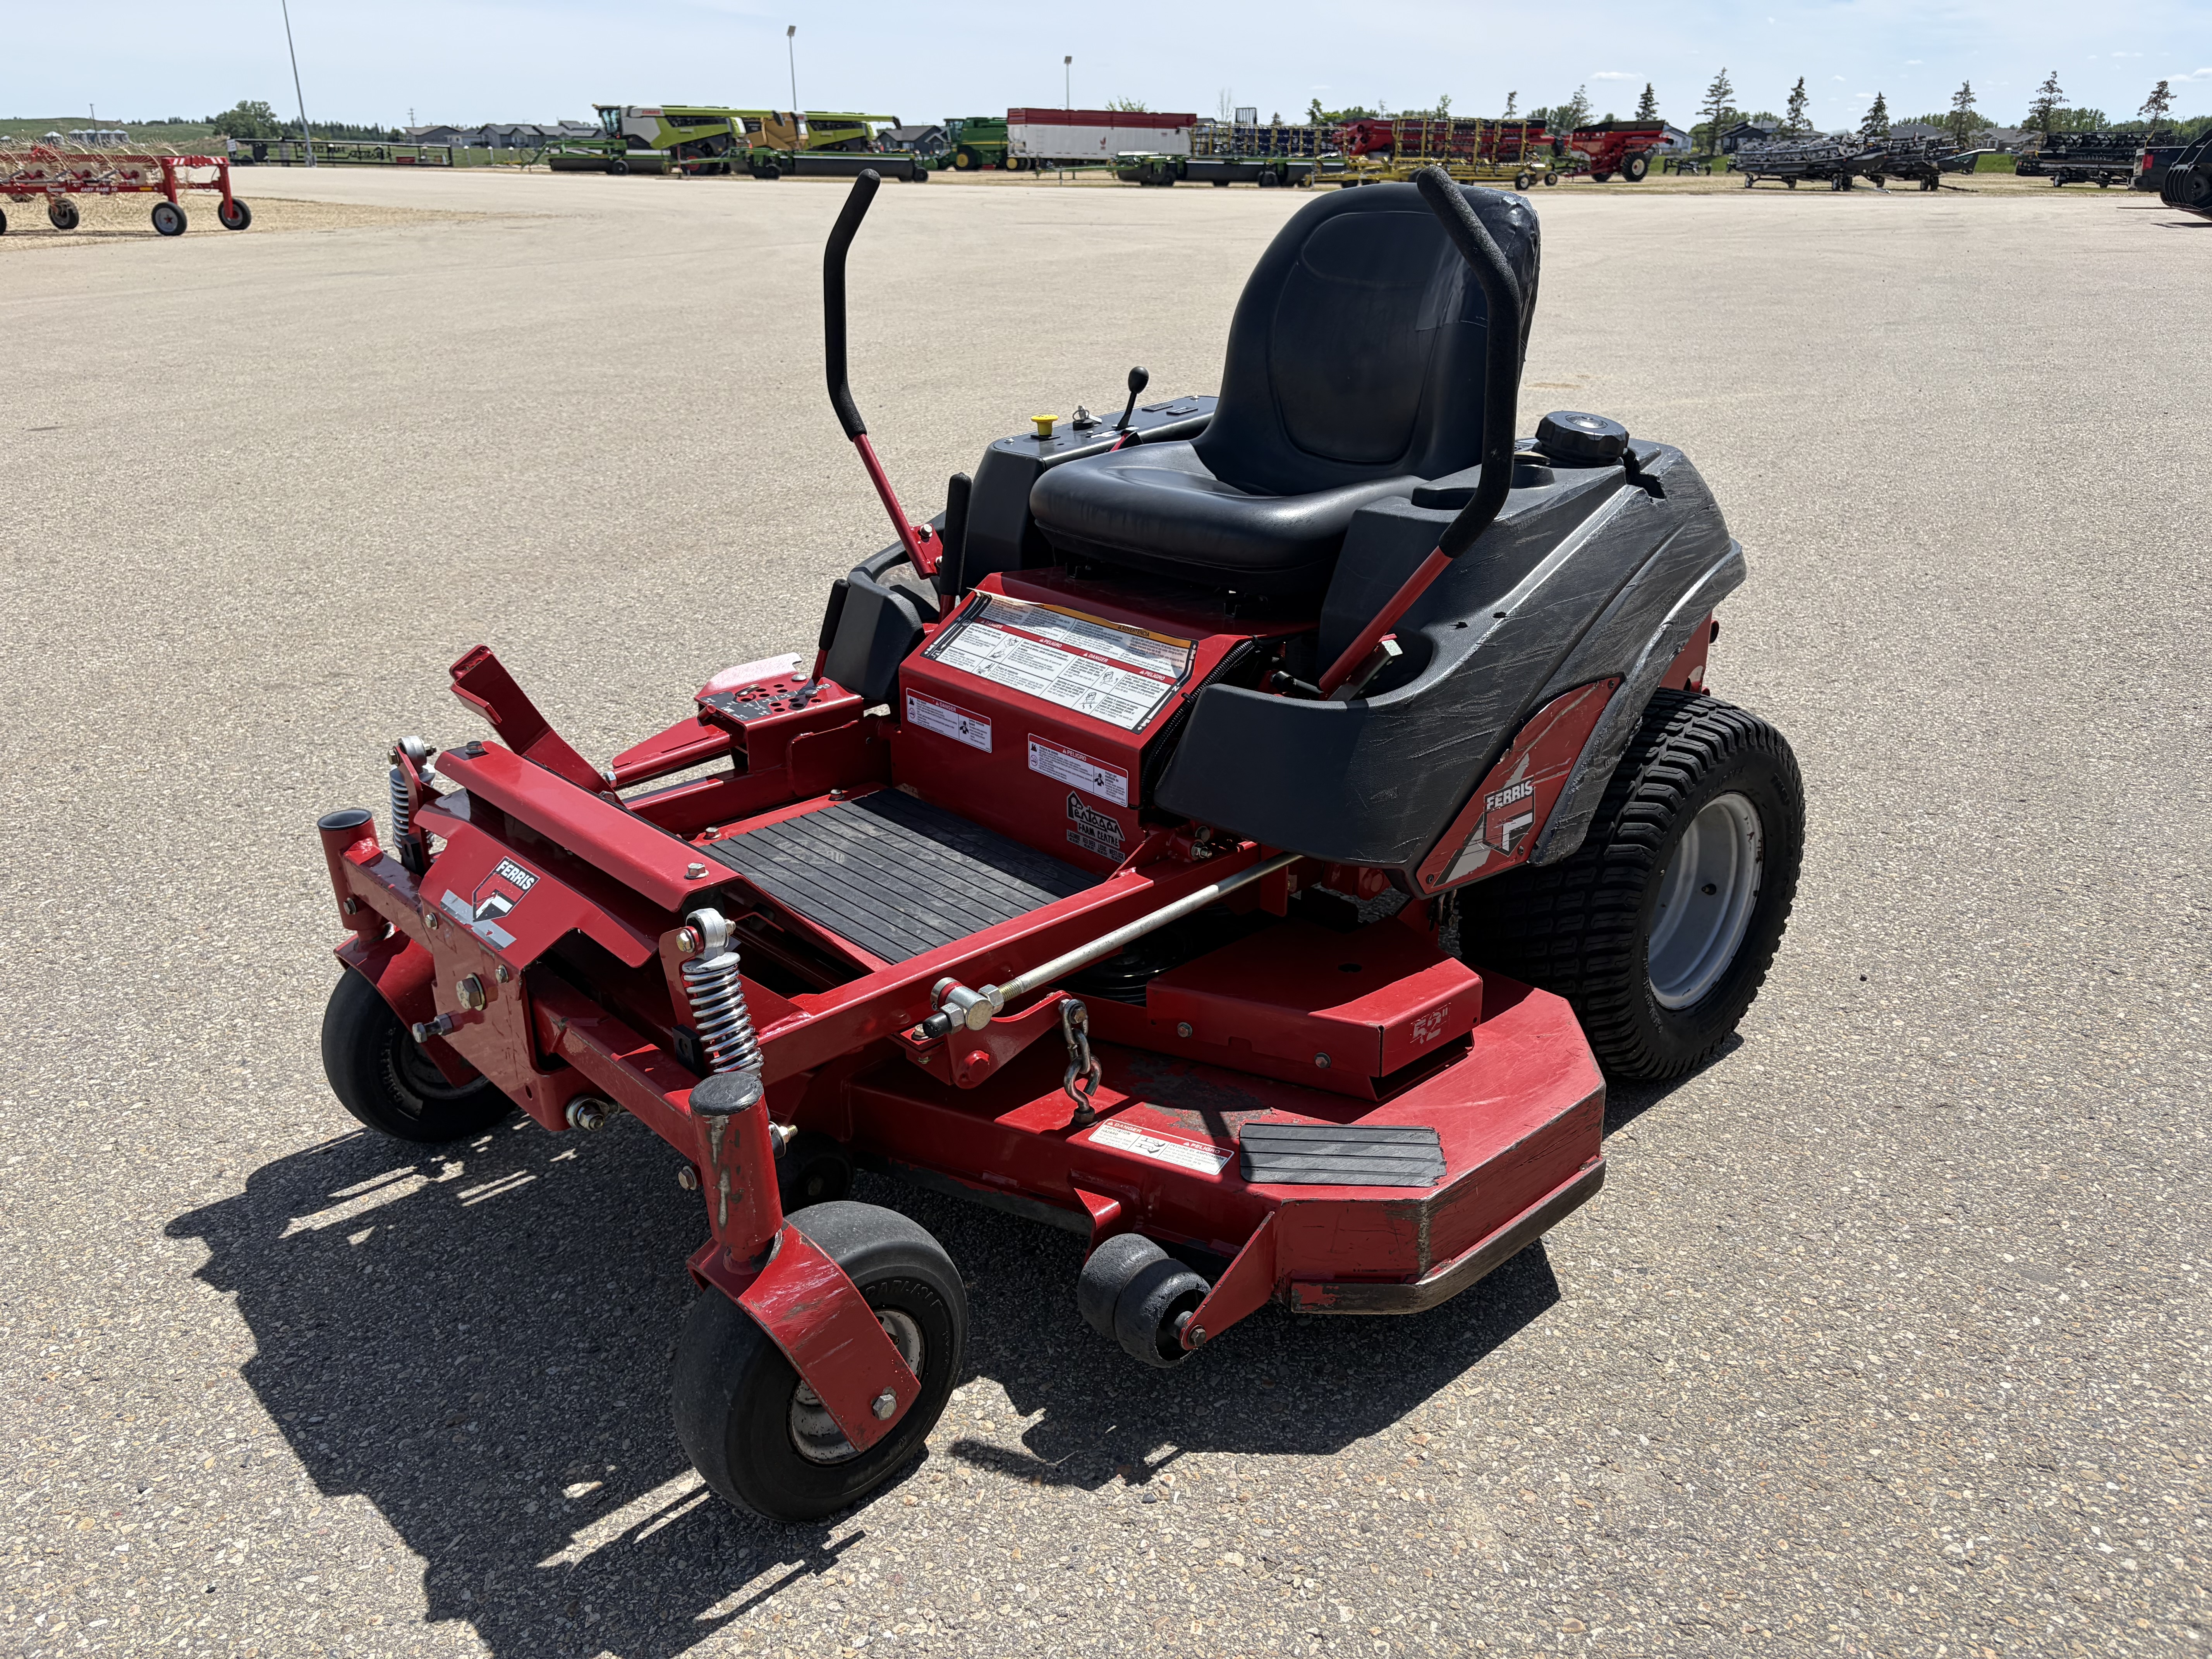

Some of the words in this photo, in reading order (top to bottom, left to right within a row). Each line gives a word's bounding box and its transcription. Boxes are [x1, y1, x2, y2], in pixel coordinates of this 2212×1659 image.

[985, 620, 1003, 629] DANGER
[1044, 639, 1063, 648] PELIGRO
[1088, 653, 1109, 663] DANGER
[1144, 671, 1165, 681] PELIGRO
[939, 702, 957, 713] DANGER
[1066, 749, 1087, 761] PELIGRO
[1486, 780, 1533, 811] FERRIS
[1079, 823, 1096, 837] FARM
[1097, 830, 1119, 847] CENTRE
[496, 860, 535, 890] FERRIS
[1114, 1123, 1142, 1133] DANGER
[1190, 1143, 1221, 1154] PELIGRO
